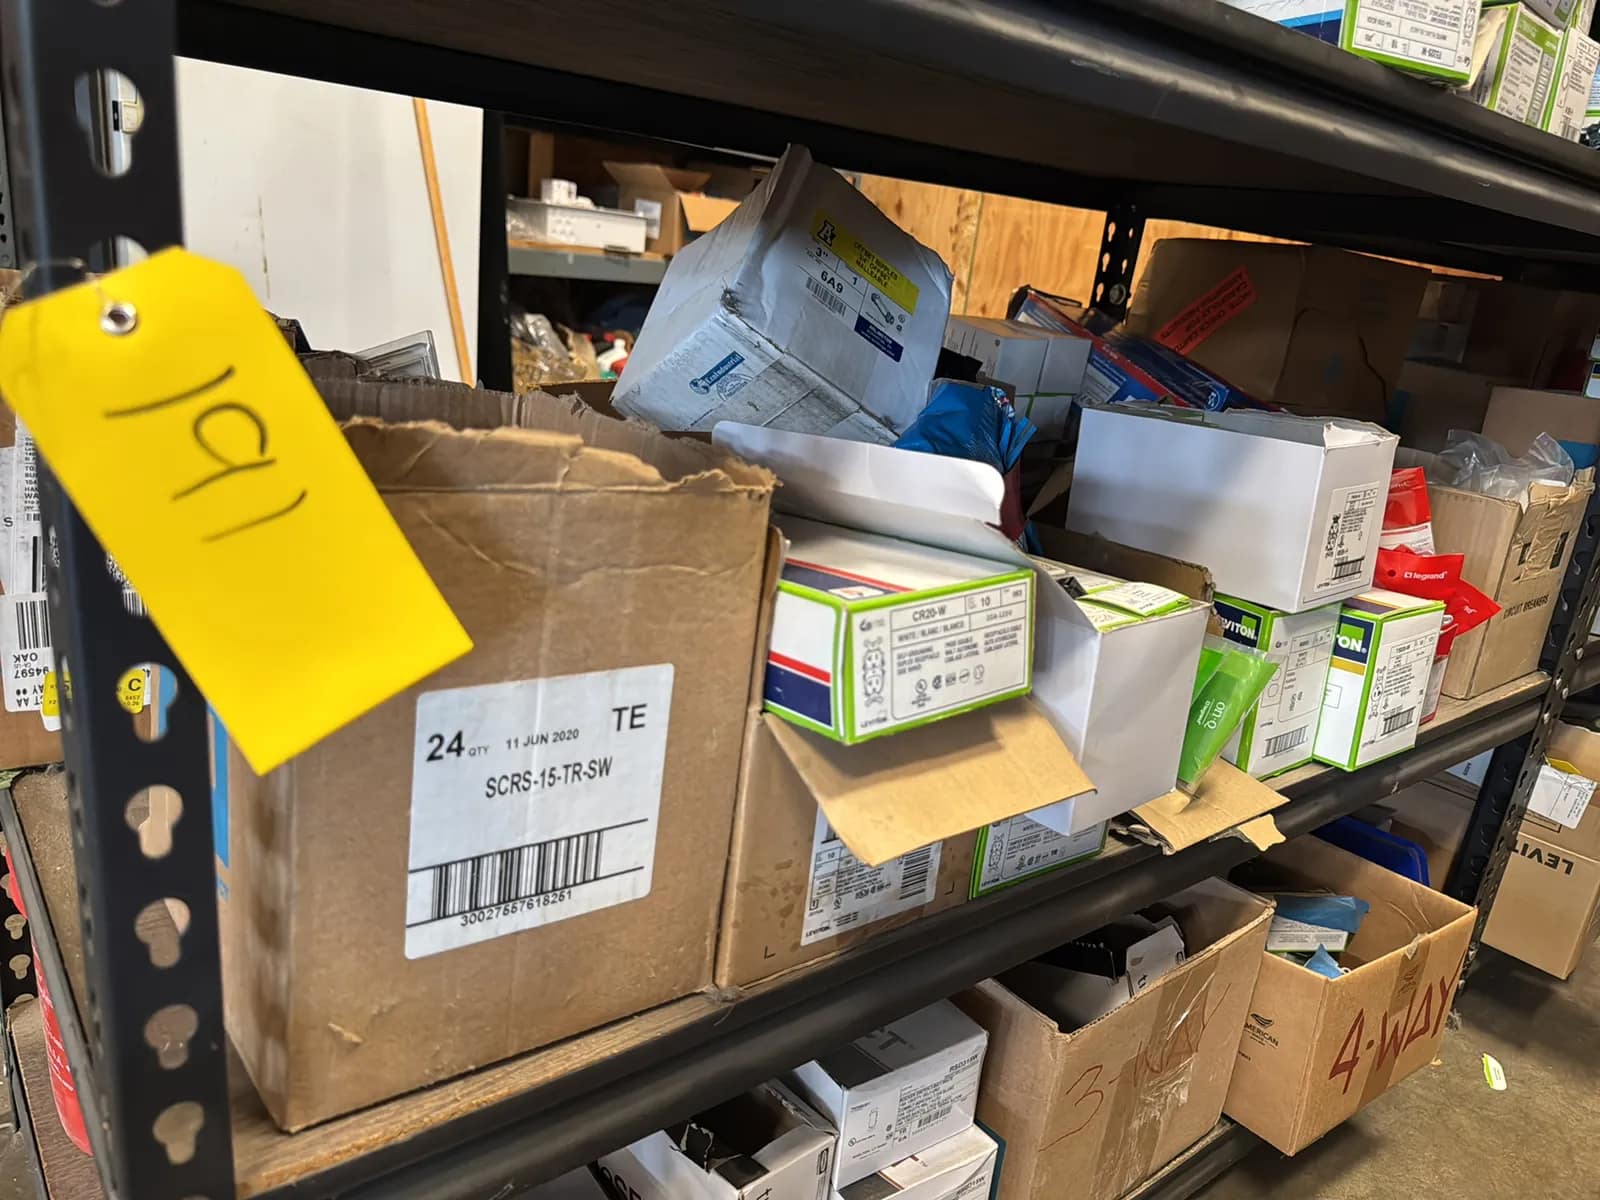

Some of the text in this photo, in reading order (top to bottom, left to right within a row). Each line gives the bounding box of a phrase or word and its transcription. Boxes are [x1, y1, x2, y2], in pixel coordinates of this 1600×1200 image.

[820, 270, 844, 294] 6A9
[1413, 571, 1445, 580] legrand
[912, 605, 947, 622] CR20-W
[12, 652, 38, 664] OAK
[128, 677, 142, 692] C
[612, 703, 648, 732] TE
[426, 728, 580, 762] 24 QTY 11 JUN 2020
[485, 756, 613, 799] SCRS-15-TR-SW
[1244, 1022, 1279, 1048] MERICAN
